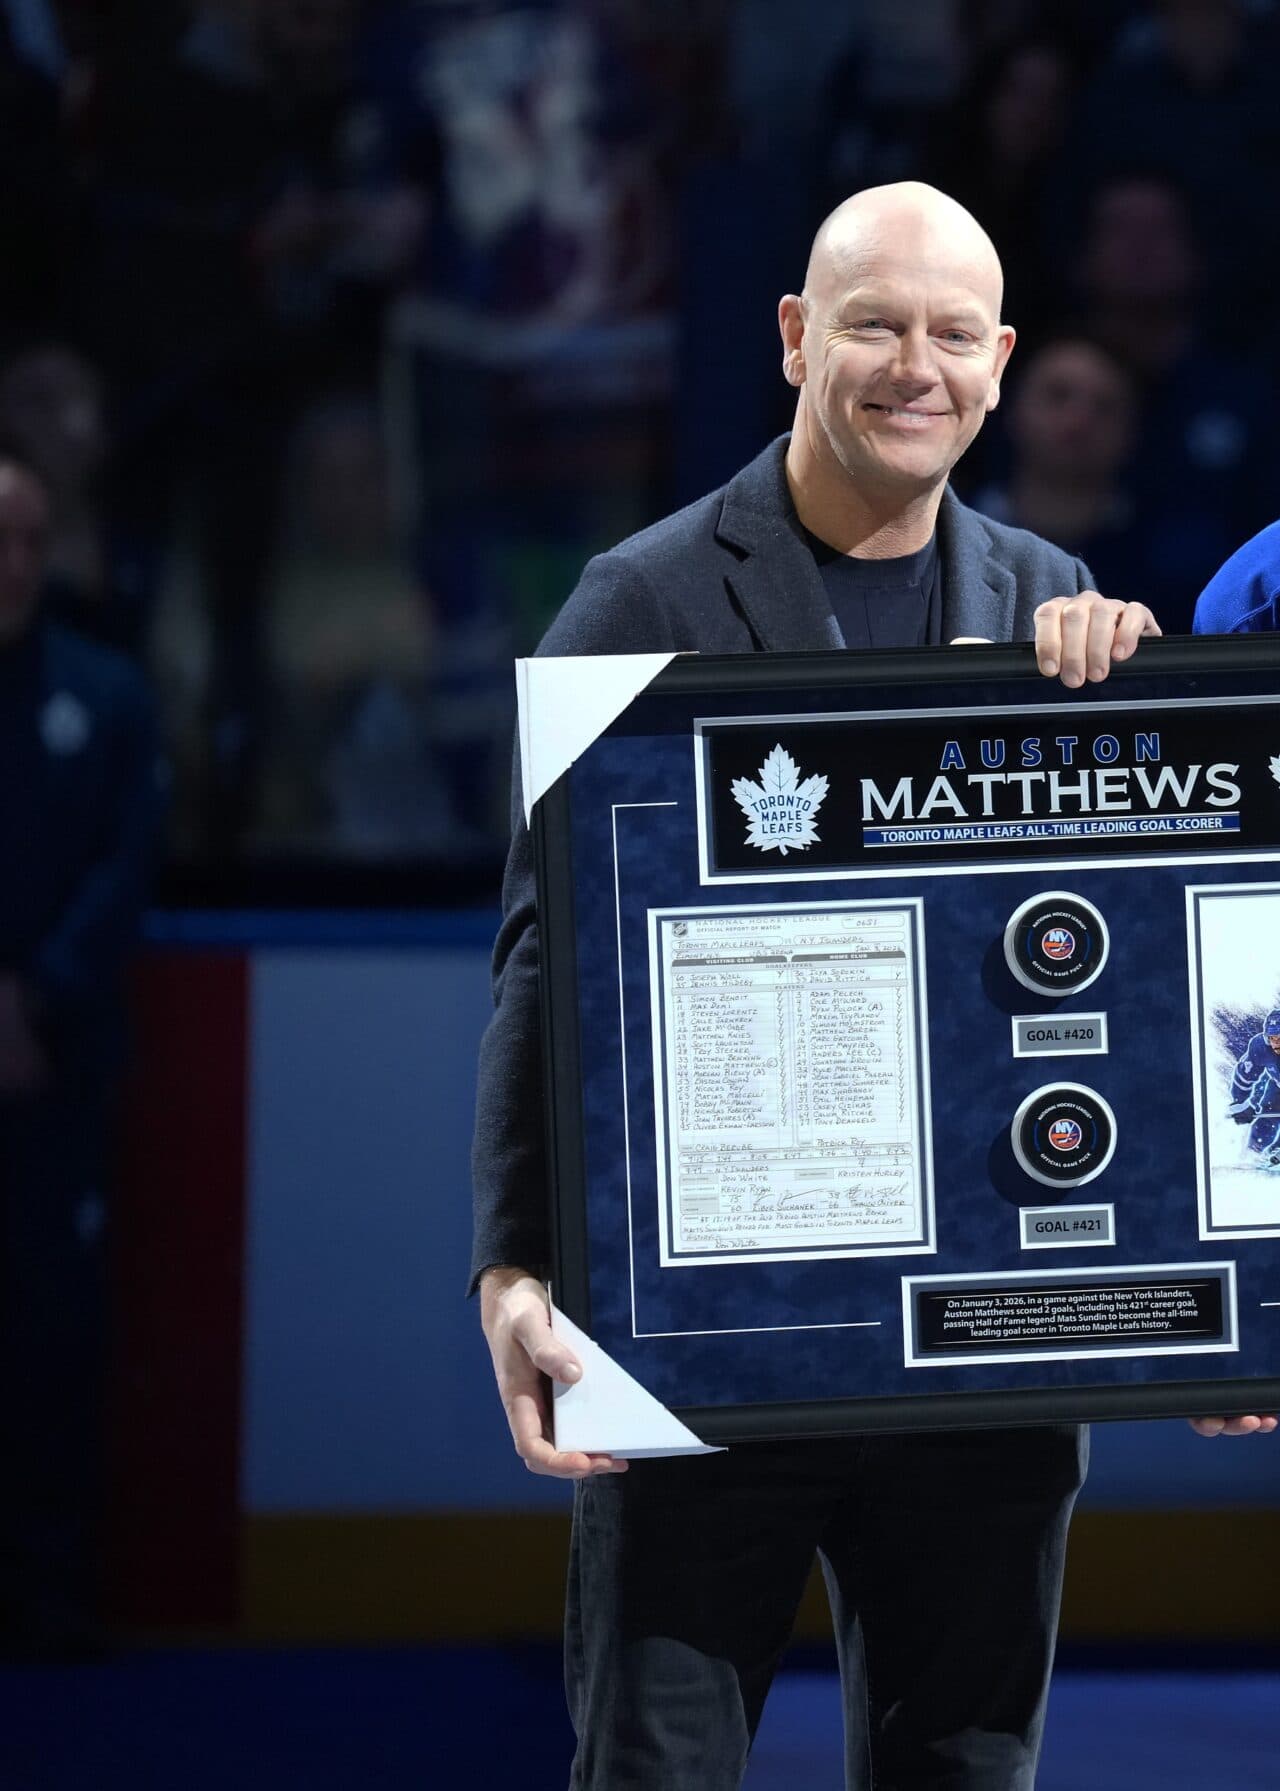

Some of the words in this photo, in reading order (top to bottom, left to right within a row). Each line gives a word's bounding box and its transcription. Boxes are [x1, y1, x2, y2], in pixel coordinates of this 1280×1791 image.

[940, 732, 1160, 770] AUSTON
[859, 762, 1240, 822] MATTHEWS
[750, 795, 811, 813] TORONTO
[762, 810, 802, 822] MAPLE
[762, 823, 802, 834] LEAFS
[881, 829, 940, 842] TORONTO
[943, 827, 984, 839] MAPLE
[988, 825, 1023, 837] LEAFS
[1026, 823, 1080, 836] ALL-TIME
[1084, 820, 1136, 833] LEADING
[1139, 819, 1172, 831] GOAL
[1176, 817, 1221, 829] SCORER
[1026, 1029, 1061, 1041] GOAL
[1064, 1028, 1094, 1041] #420
[1040, 1153, 1062, 1168] OFFICIAL
[1078, 1152, 1092, 1164] PUCK
[1035, 1220, 1070, 1233] GOAL
[1072, 1219, 1101, 1232] #421
[943, 1309, 973, 1318] Auston
[974, 1307, 1014, 1316] Matthews
[1016, 1306, 1042, 1314] scored
[1051, 1304, 1075, 1314] goals,
[1076, 1302, 1114, 1313] including
[1115, 1302, 1128, 1310] his
[1176, 1298, 1196, 1308] goal,
[947, 1300, 959, 1308] On
[961, 1298, 993, 1308] January
[994, 1298, 1002, 1306] 3,
[1003, 1297, 1025, 1305] 2026,
[1027, 1296, 1035, 1304] in
[1043, 1296, 1066, 1305] game
[1068, 1293, 1097, 1303] against
[1099, 1292, 1112, 1300] the
[1114, 1291, 1132, 1300] New
[1133, 1290, 1152, 1299] York
[1154, 1289, 1192, 1298] Islanders,
[943, 1319, 974, 1329] passing
[975, 1318, 991, 1326] Hall
[993, 1317, 1002, 1325] of
[1003, 1317, 1025, 1325] Fame
[1027, 1315, 1055, 1325] legend
[1057, 1314, 1076, 1322] Mats
[1078, 1312, 1106, 1321] Sundin
[1118, 1310, 1151, 1319] become
[1152, 1310, 1165, 1318] the
[1167, 1308, 1198, 1317] all-time
[970, 1328, 1000, 1338] leading
[1002, 1327, 1020, 1336] goal
[1058, 1323, 1090, 1332] Toronto
[1092, 1322, 1117, 1331] Maple
[1118, 1321, 1139, 1329] Leafs
[1141, 1319, 1171, 1329] history.
